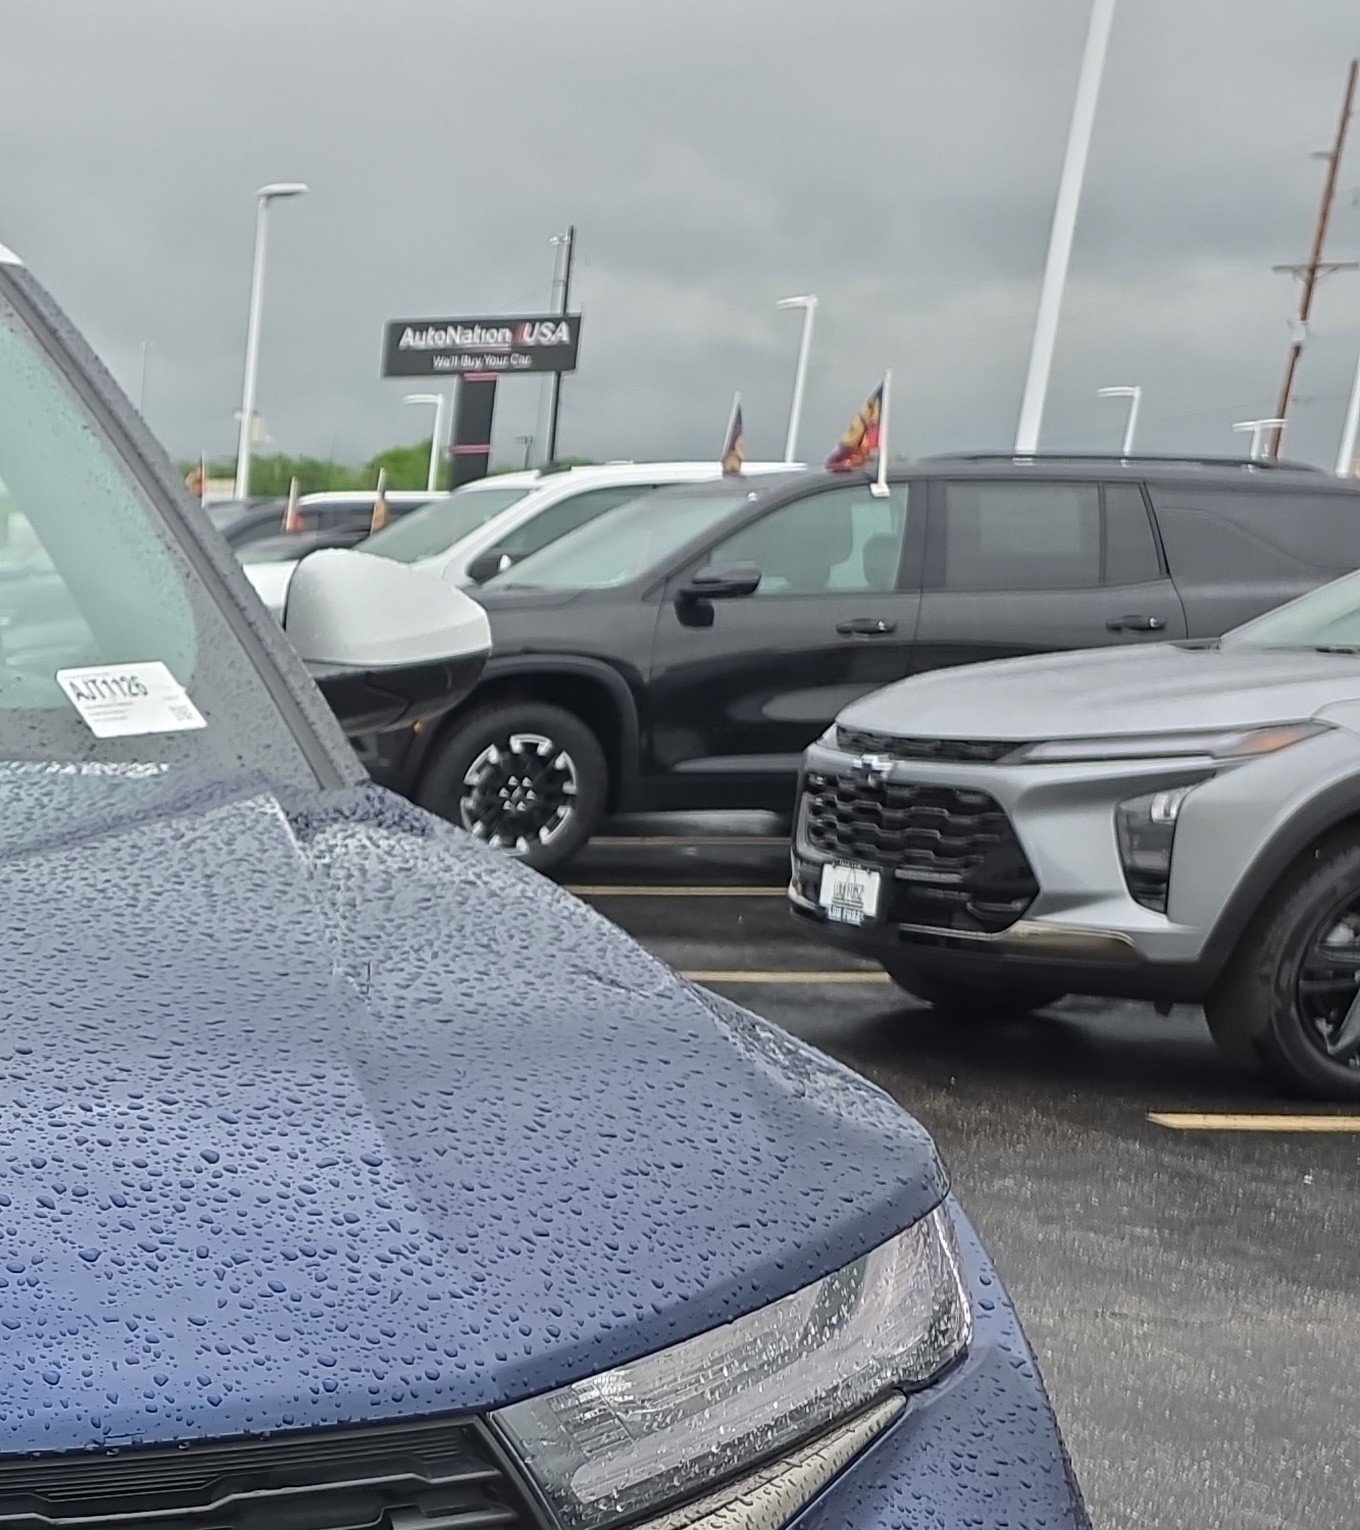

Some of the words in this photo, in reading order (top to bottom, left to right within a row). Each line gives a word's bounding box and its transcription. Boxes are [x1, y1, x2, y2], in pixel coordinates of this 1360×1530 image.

[399, 324, 512, 349] AutoNation
[522, 321, 570, 346] USA
[460, 354, 481, 369] Buy
[483, 353, 507, 368] Your
